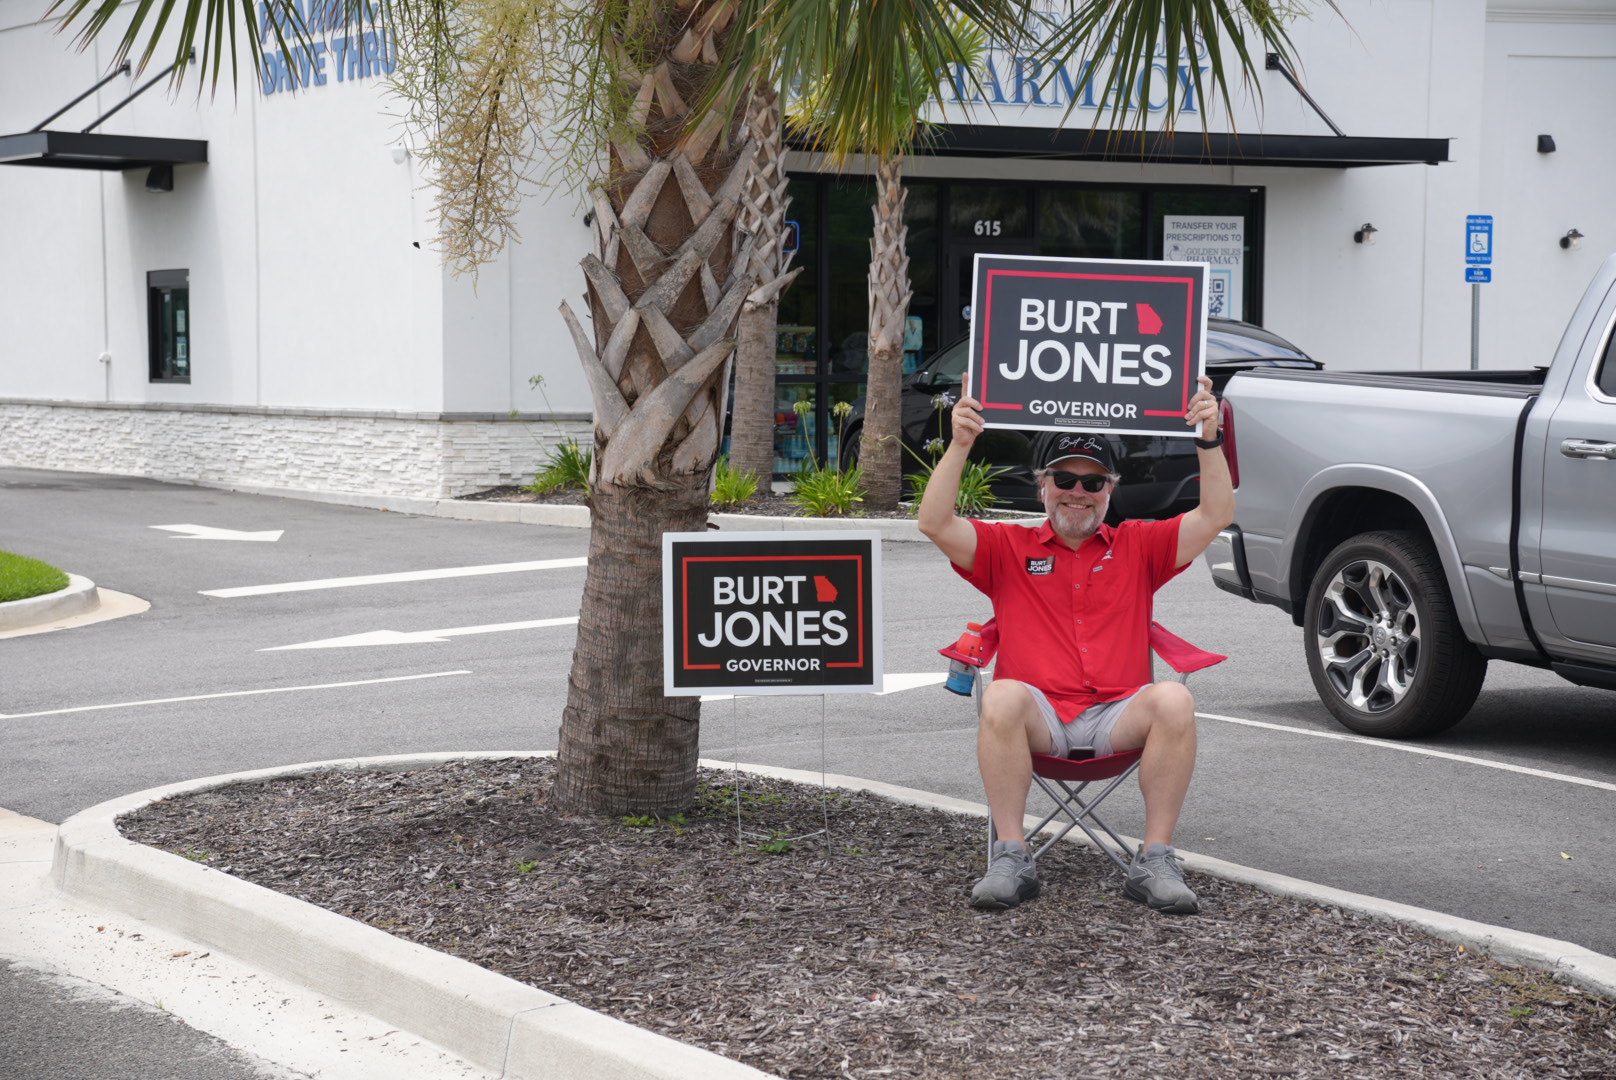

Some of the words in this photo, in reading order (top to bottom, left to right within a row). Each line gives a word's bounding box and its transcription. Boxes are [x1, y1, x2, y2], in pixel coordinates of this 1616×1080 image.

[261, 41, 328, 96] DRIVE
[332, 27, 397, 82] THRU
[928, 54, 1209, 113] HARMACY
[974, 220, 1001, 236] 615
[1166, 233, 1229, 242] PRESCRIPTIONS
[1019, 298, 1127, 335] BURT
[999, 339, 1172, 387] JONES
[1029, 399, 1137, 419] GOVERNOR
[1059, 436, 1084, 450] Burt
[713, 575, 806, 605] BURT
[697, 609, 849, 648] JONES
[726, 658, 821, 672] GOVERNOR
